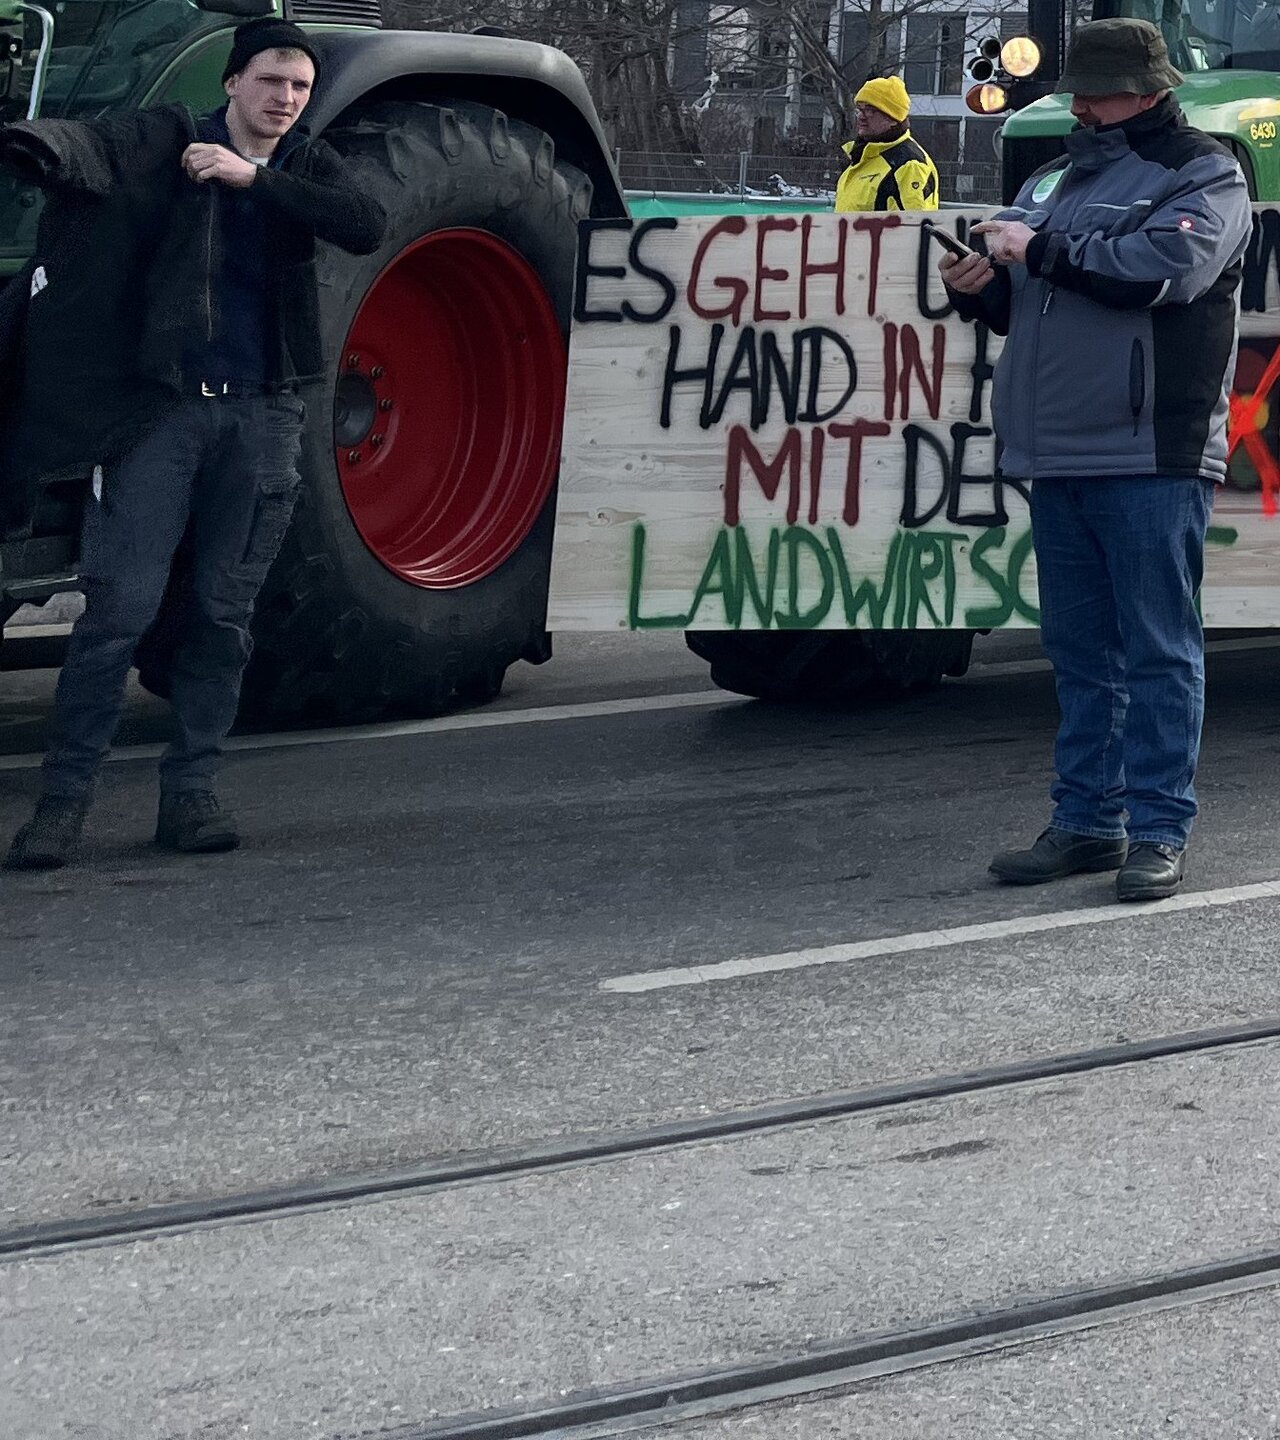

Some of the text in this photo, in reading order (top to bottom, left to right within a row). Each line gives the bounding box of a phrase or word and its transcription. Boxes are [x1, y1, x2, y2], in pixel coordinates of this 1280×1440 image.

[1250, 122, 1276, 140] 6430
[573, 218, 679, 324] ES
[687, 214, 900, 327] GEHT
[659, 323, 858, 430] HAND
[882, 322, 946, 421] IN
[724, 417, 891, 527] MIT
